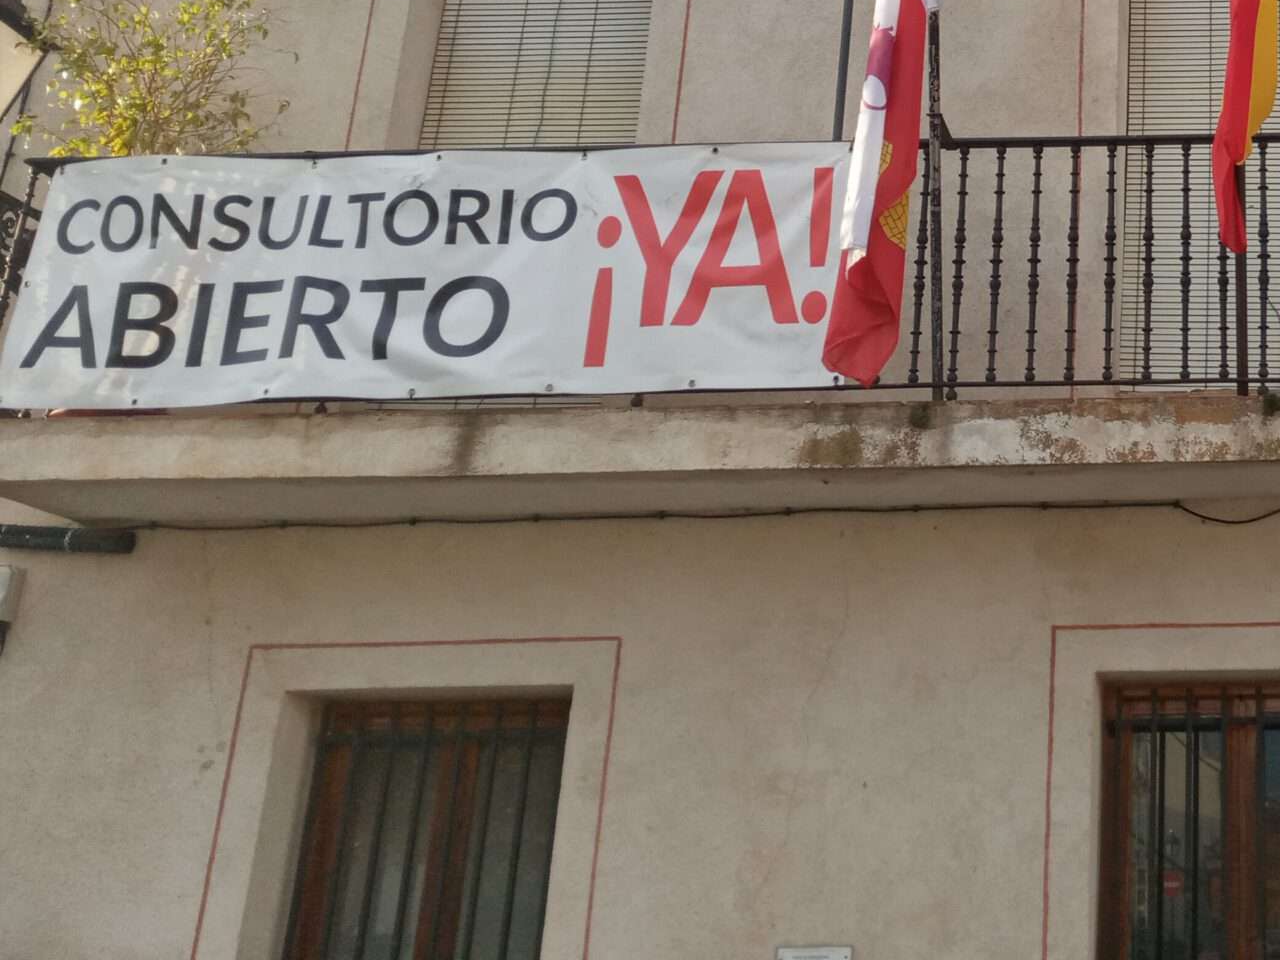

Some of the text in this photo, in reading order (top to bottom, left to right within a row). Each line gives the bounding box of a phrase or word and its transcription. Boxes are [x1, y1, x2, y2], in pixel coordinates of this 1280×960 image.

[56, 188, 578, 253] CONSULTORIO
[583, 167, 834, 368] ¡YA!
[19, 276, 510, 369] ABIERTO
